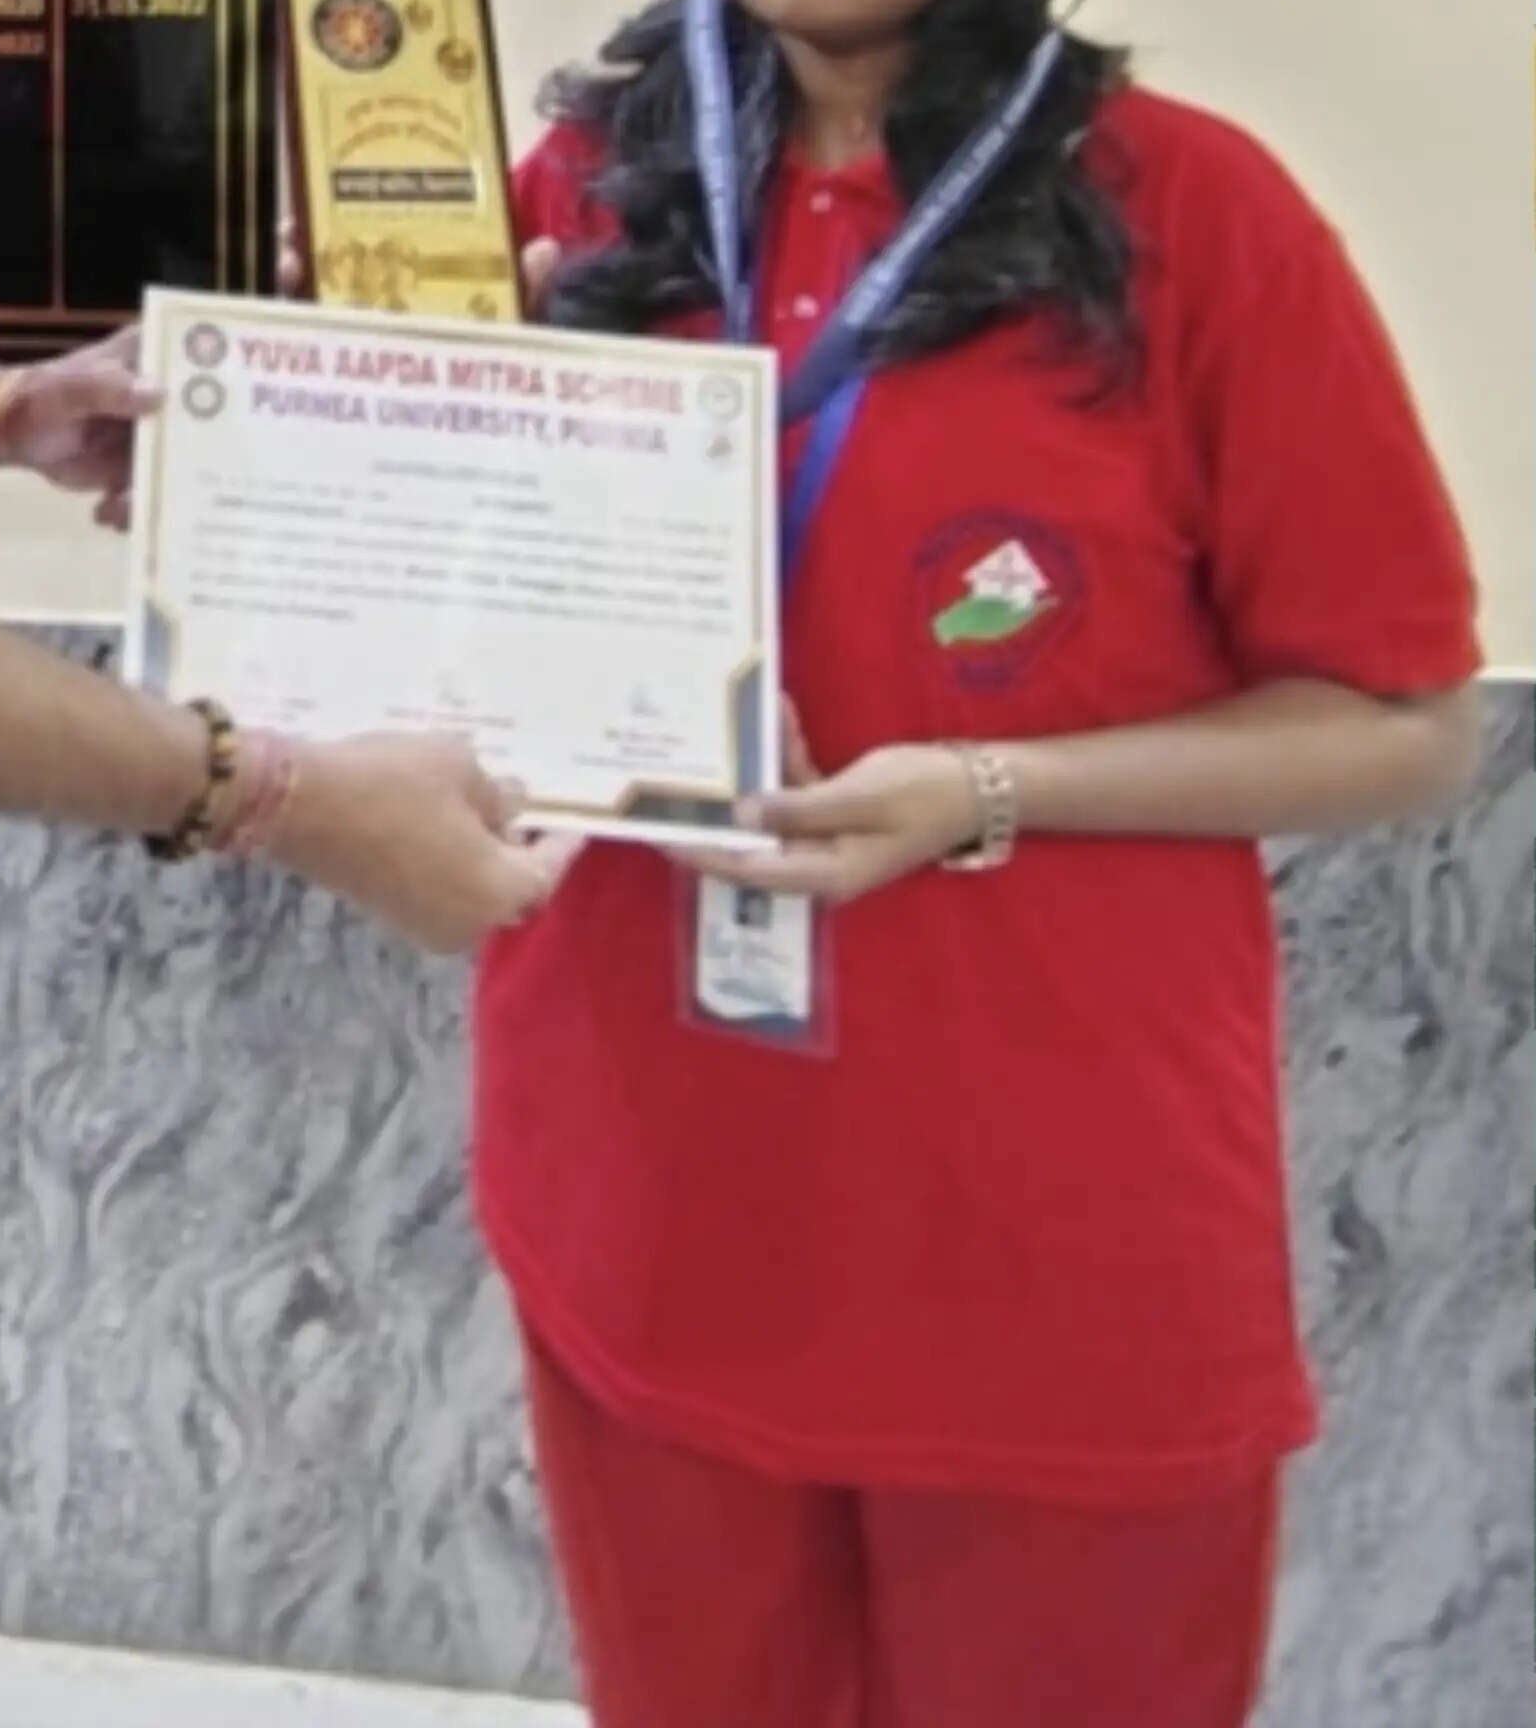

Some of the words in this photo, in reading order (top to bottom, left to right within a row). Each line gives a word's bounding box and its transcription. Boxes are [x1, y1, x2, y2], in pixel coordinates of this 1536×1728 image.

[239, 339, 324, 373] YUVA
[335, 347, 438, 386] AAPDA
[447, 358, 544, 397] MITRA
[250, 385, 366, 424] PURNEA
